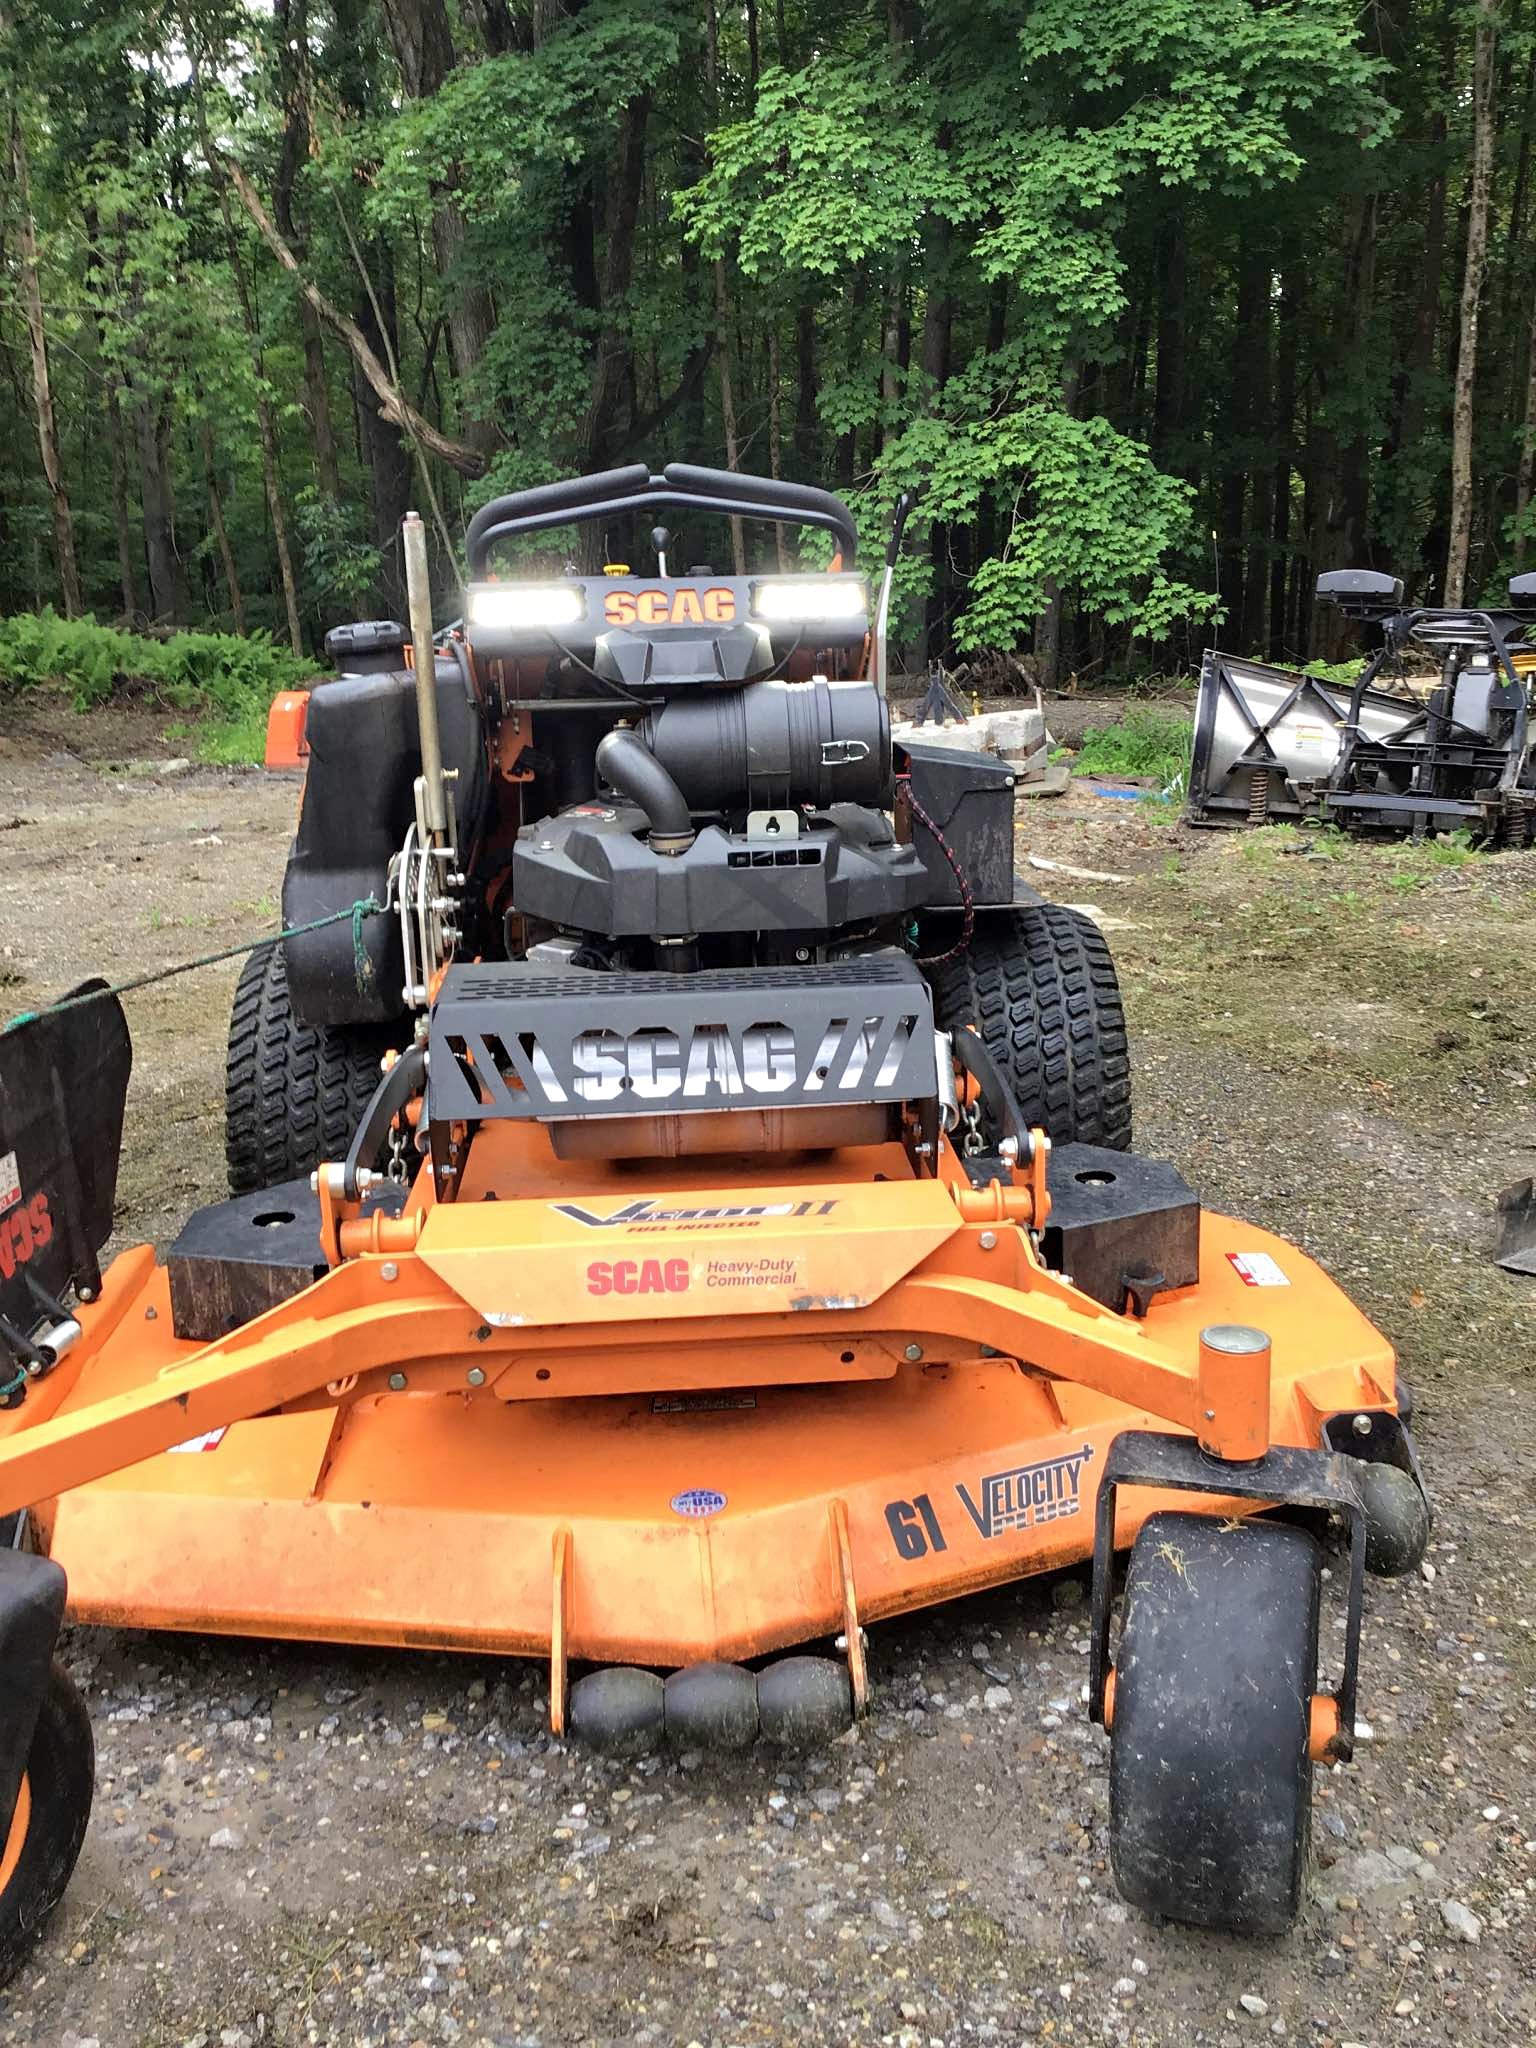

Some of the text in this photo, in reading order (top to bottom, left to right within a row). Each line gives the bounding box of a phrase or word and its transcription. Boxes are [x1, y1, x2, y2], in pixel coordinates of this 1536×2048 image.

[604, 587, 736, 625] SCAG
[572, 1021, 797, 1101] SCAG
[0, 1192, 53, 1279] SCA
[587, 1258, 689, 1295] SCAG
[706, 1271, 797, 1288] Commercial
[707, 1258, 794, 1273] Heavy-Duty
[884, 1493, 947, 1560] 61
[993, 1497, 1080, 1537] PLUS
